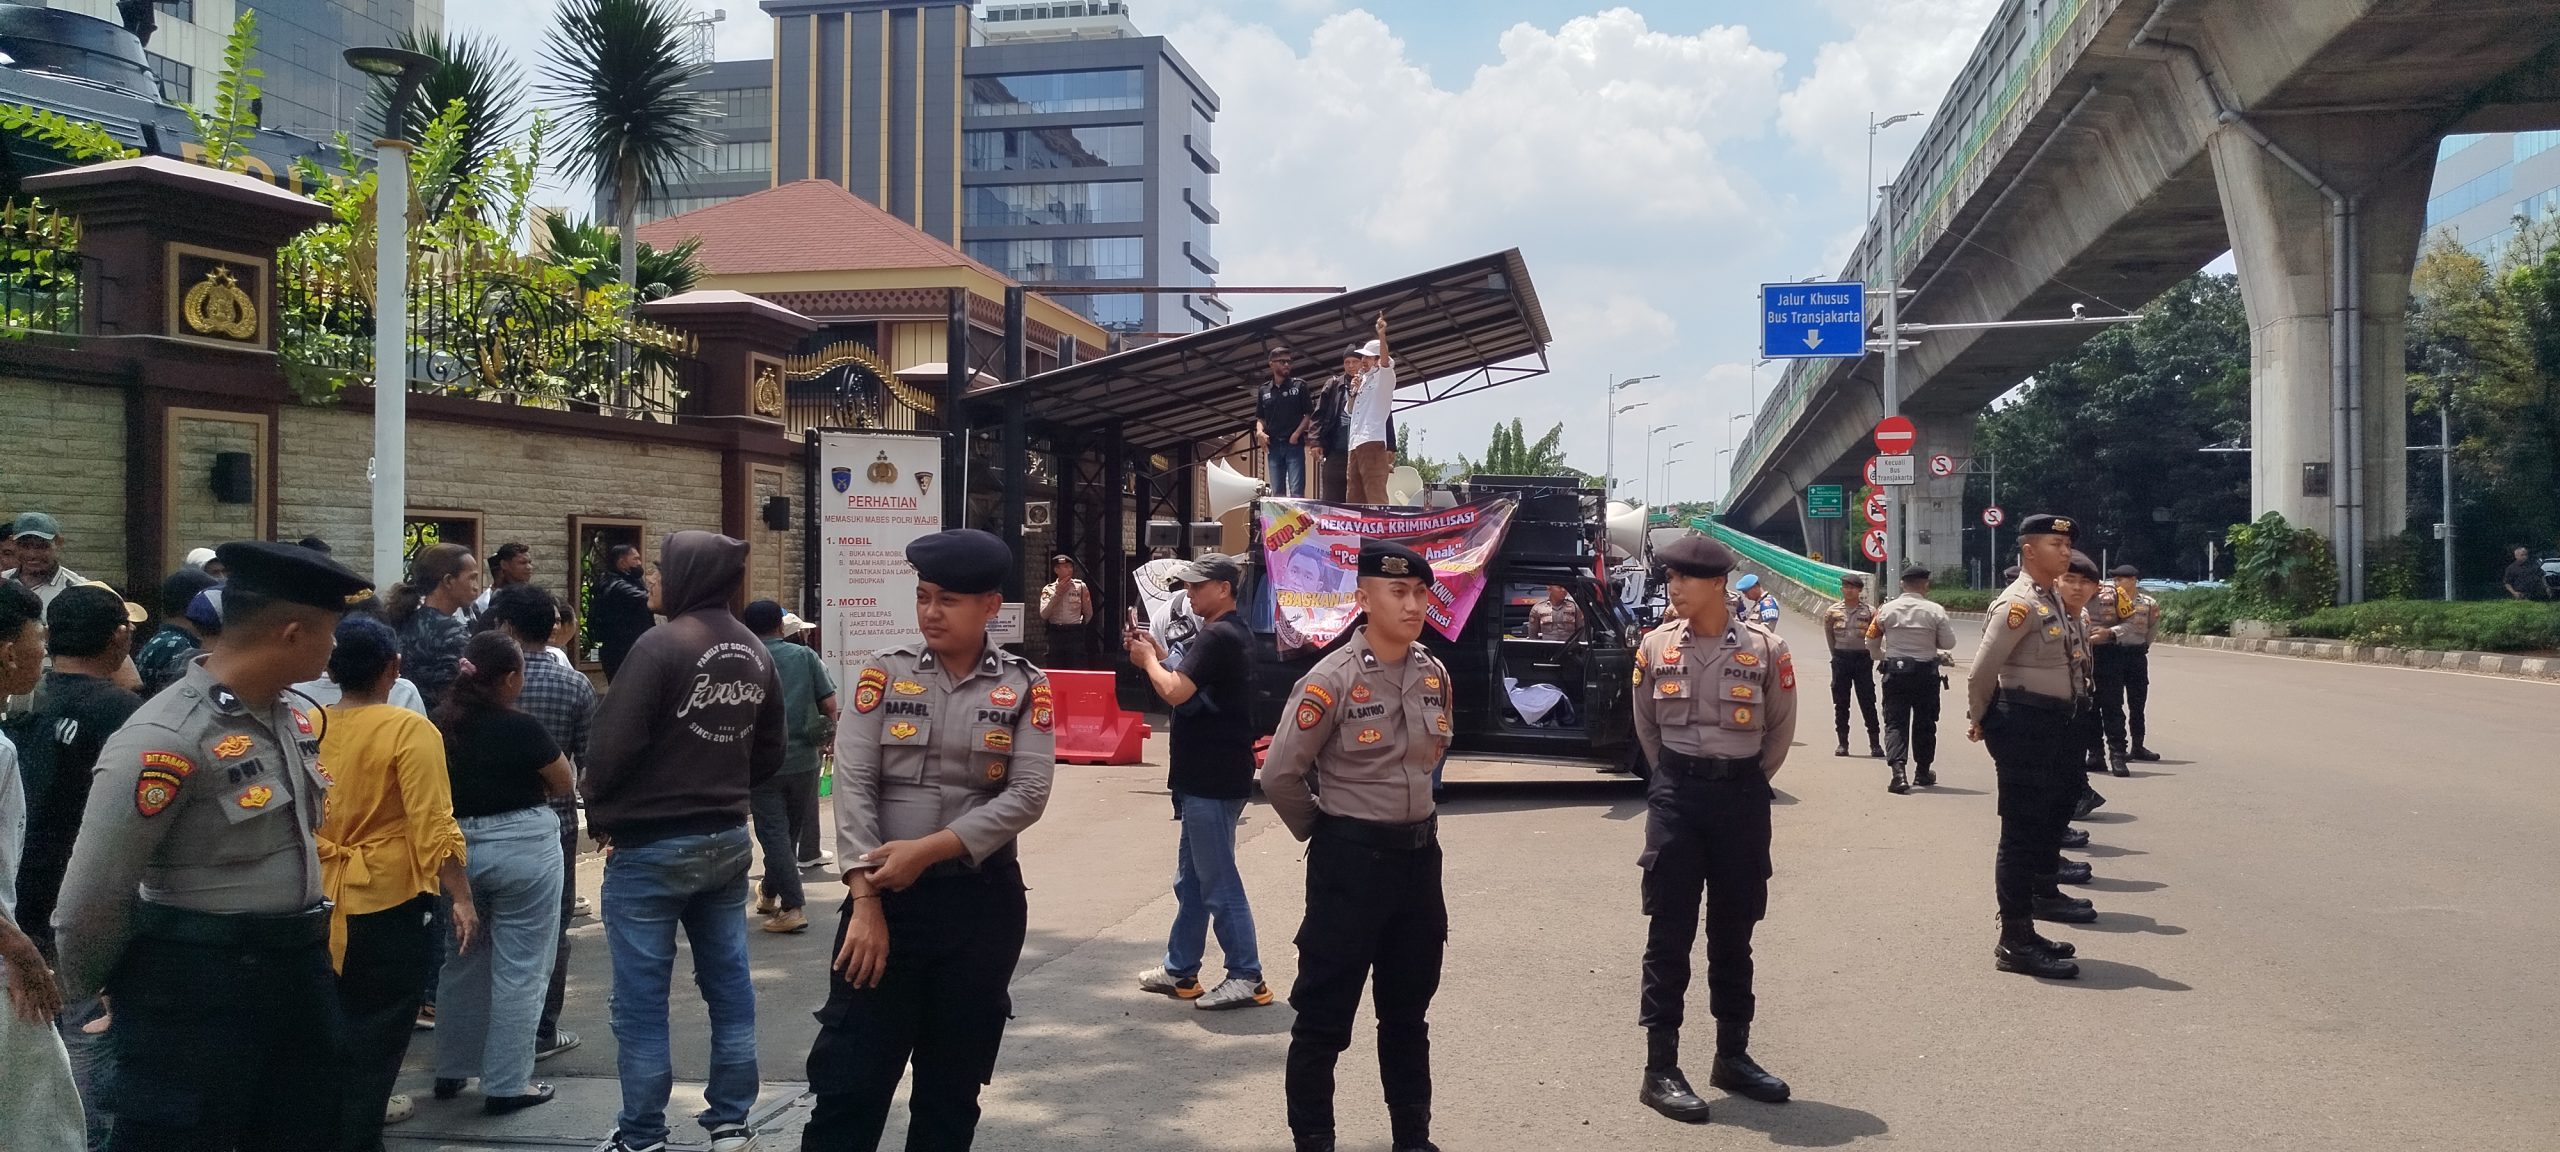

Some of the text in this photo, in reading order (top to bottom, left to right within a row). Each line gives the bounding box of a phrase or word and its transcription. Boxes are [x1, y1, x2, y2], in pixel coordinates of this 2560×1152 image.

[1777, 292, 1850, 306] Jalur Khusus
[1768, 310, 1860, 326] Bus Transjakarta
[848, 496, 917, 508] PERHATIAN
[914, 516, 938, 524] WAJIB
[1320, 512, 1475, 534] REKAYASA KRIMINALISASI
[826, 536, 836, 544] 1.
[1429, 580, 1456, 607] KNUM
[696, 645, 720, 668] FAMILY
[730, 642, 756, 657] SOCIAL
[1724, 668, 1762, 681] POLRI
[886, 702, 928, 716] RAFAEL
[1358, 704, 1385, 718] SATRIO
[689, 722, 713, 740] SINCE
[714, 734, 734, 742] 2014
[740, 724, 754, 739] 2017
